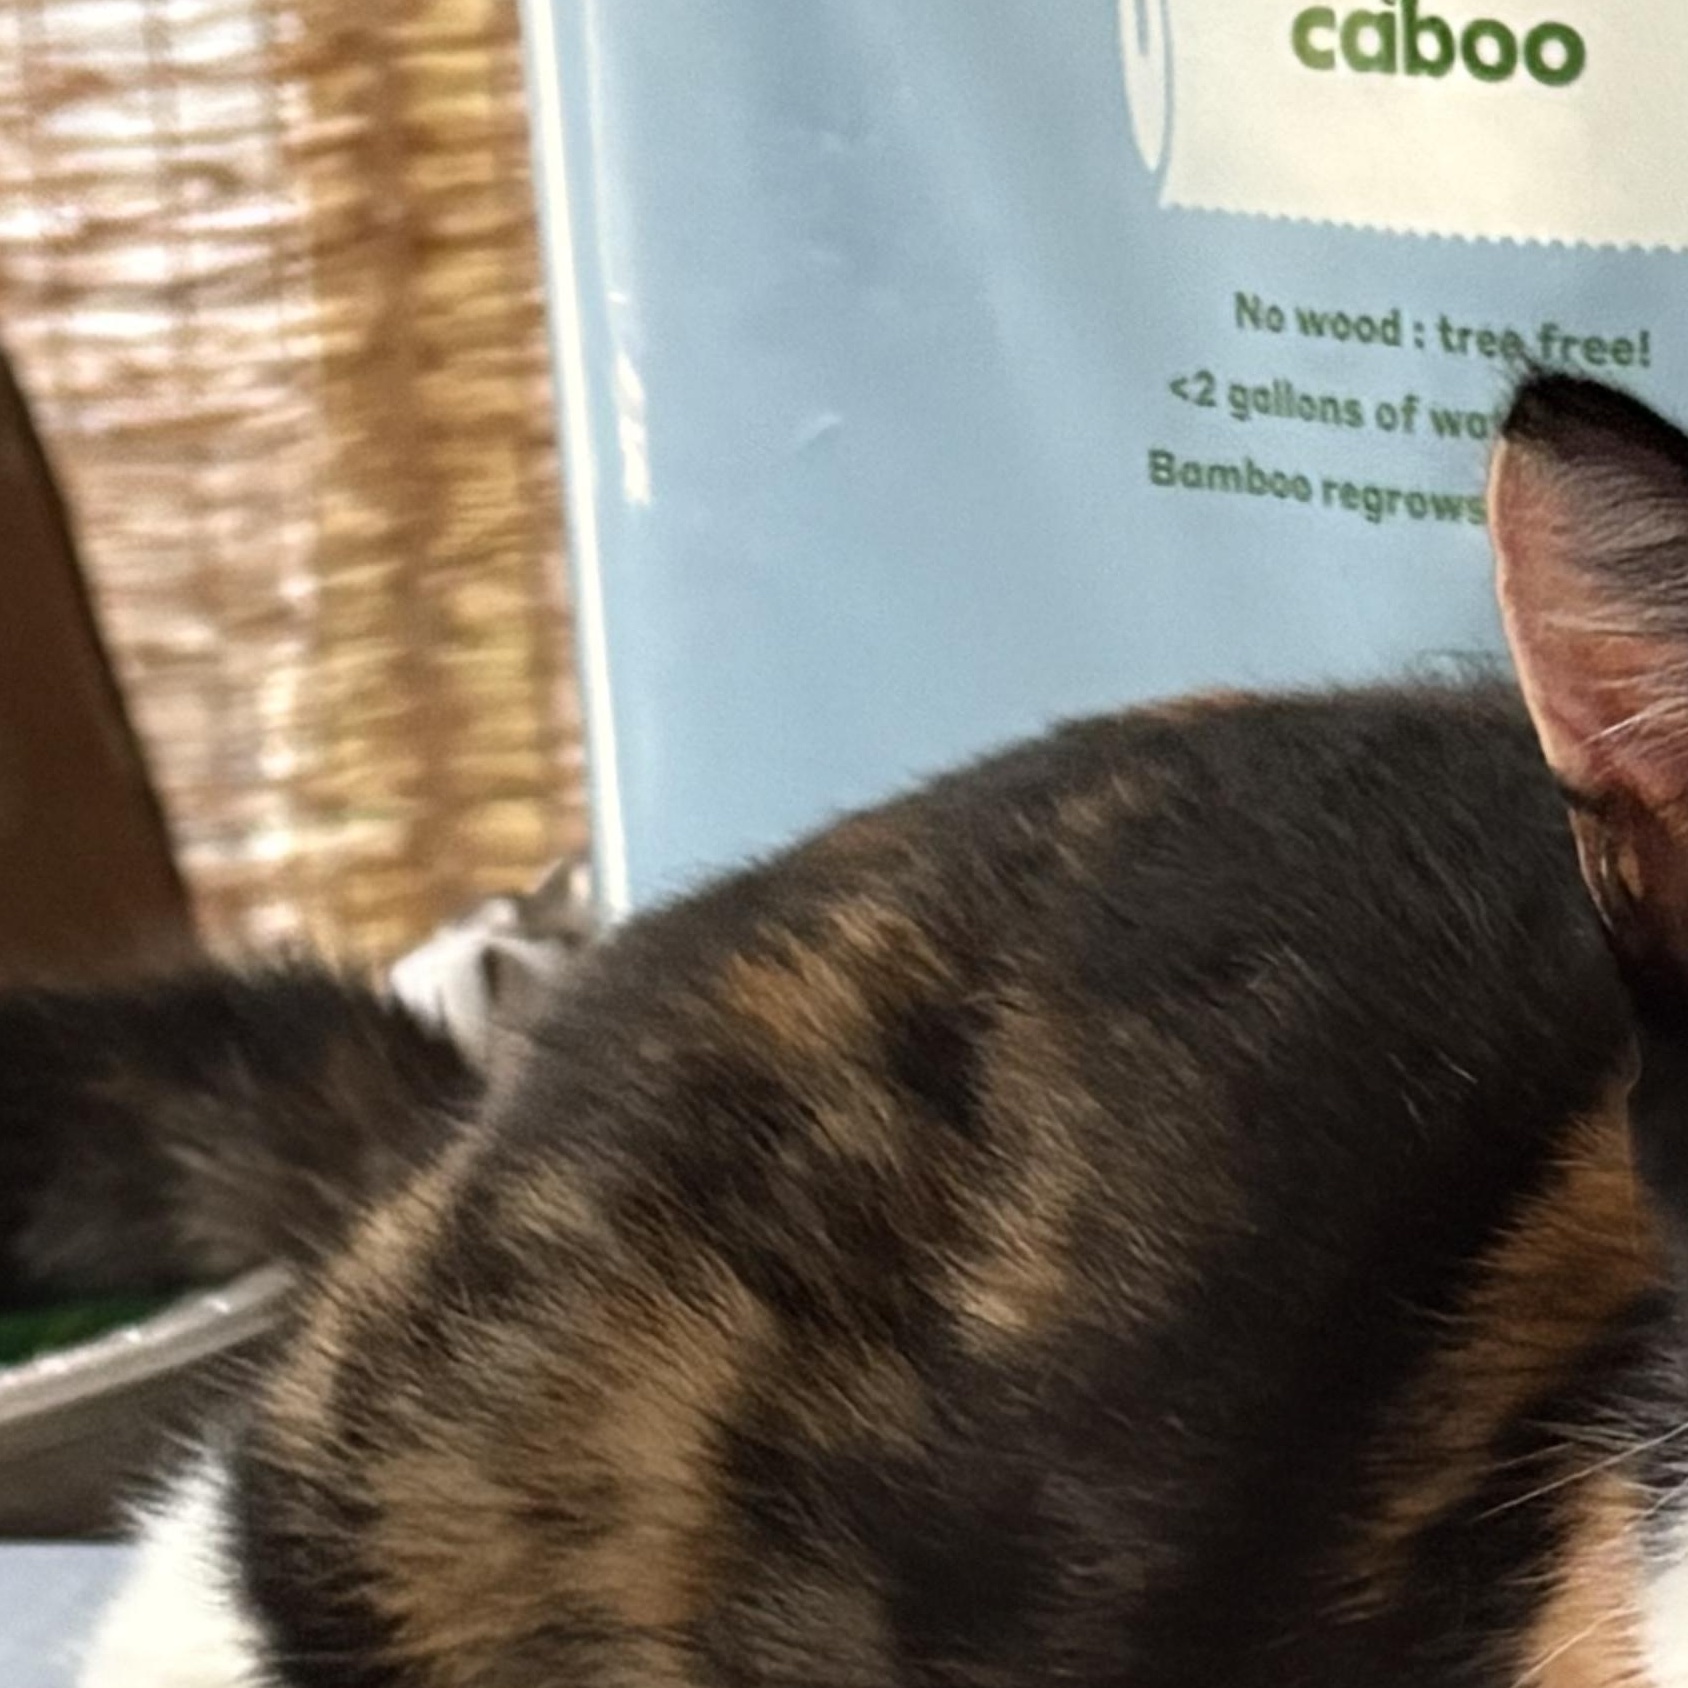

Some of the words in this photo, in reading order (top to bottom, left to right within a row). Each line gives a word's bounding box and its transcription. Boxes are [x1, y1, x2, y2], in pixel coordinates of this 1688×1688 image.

[1291, 0, 1586, 87] caboo
[1234, 291, 1285, 333] No
[1296, 307, 1401, 347] wood
[1438, 313, 1525, 362] tree
[1538, 321, 1650, 367] free!
[1168, 368, 1217, 408] <2
[1227, 377, 1365, 422] gallons
[1374, 393, 1420, 434] of
[1148, 448, 1312, 503] Bamboo
[1322, 478, 1488, 525] regrows
